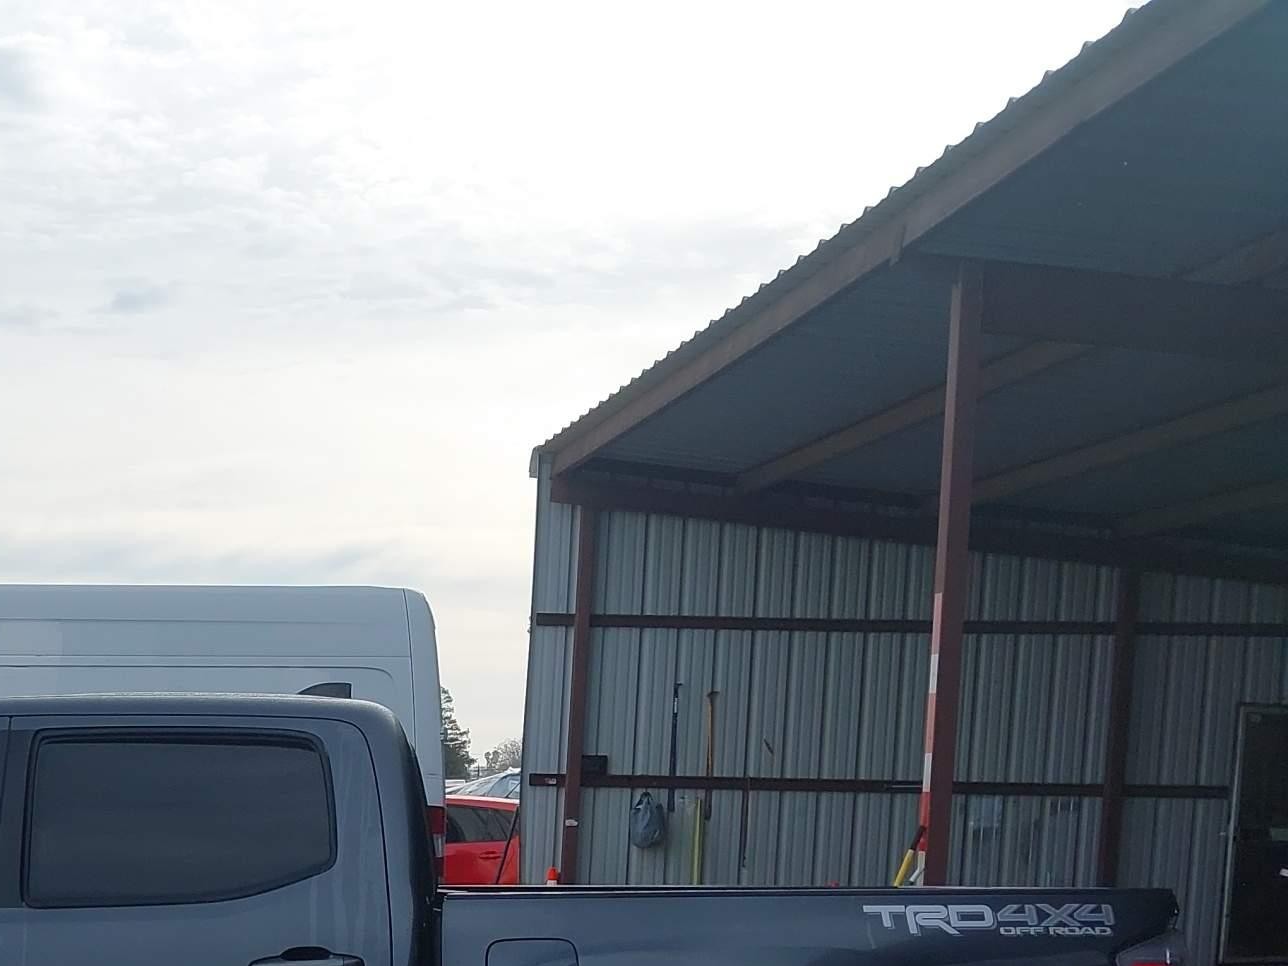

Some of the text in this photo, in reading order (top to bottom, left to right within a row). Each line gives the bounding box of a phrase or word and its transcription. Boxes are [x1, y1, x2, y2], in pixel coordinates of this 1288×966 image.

[862, 904, 997, 937] TRD
[999, 926, 1113, 936] OFF ROAD
